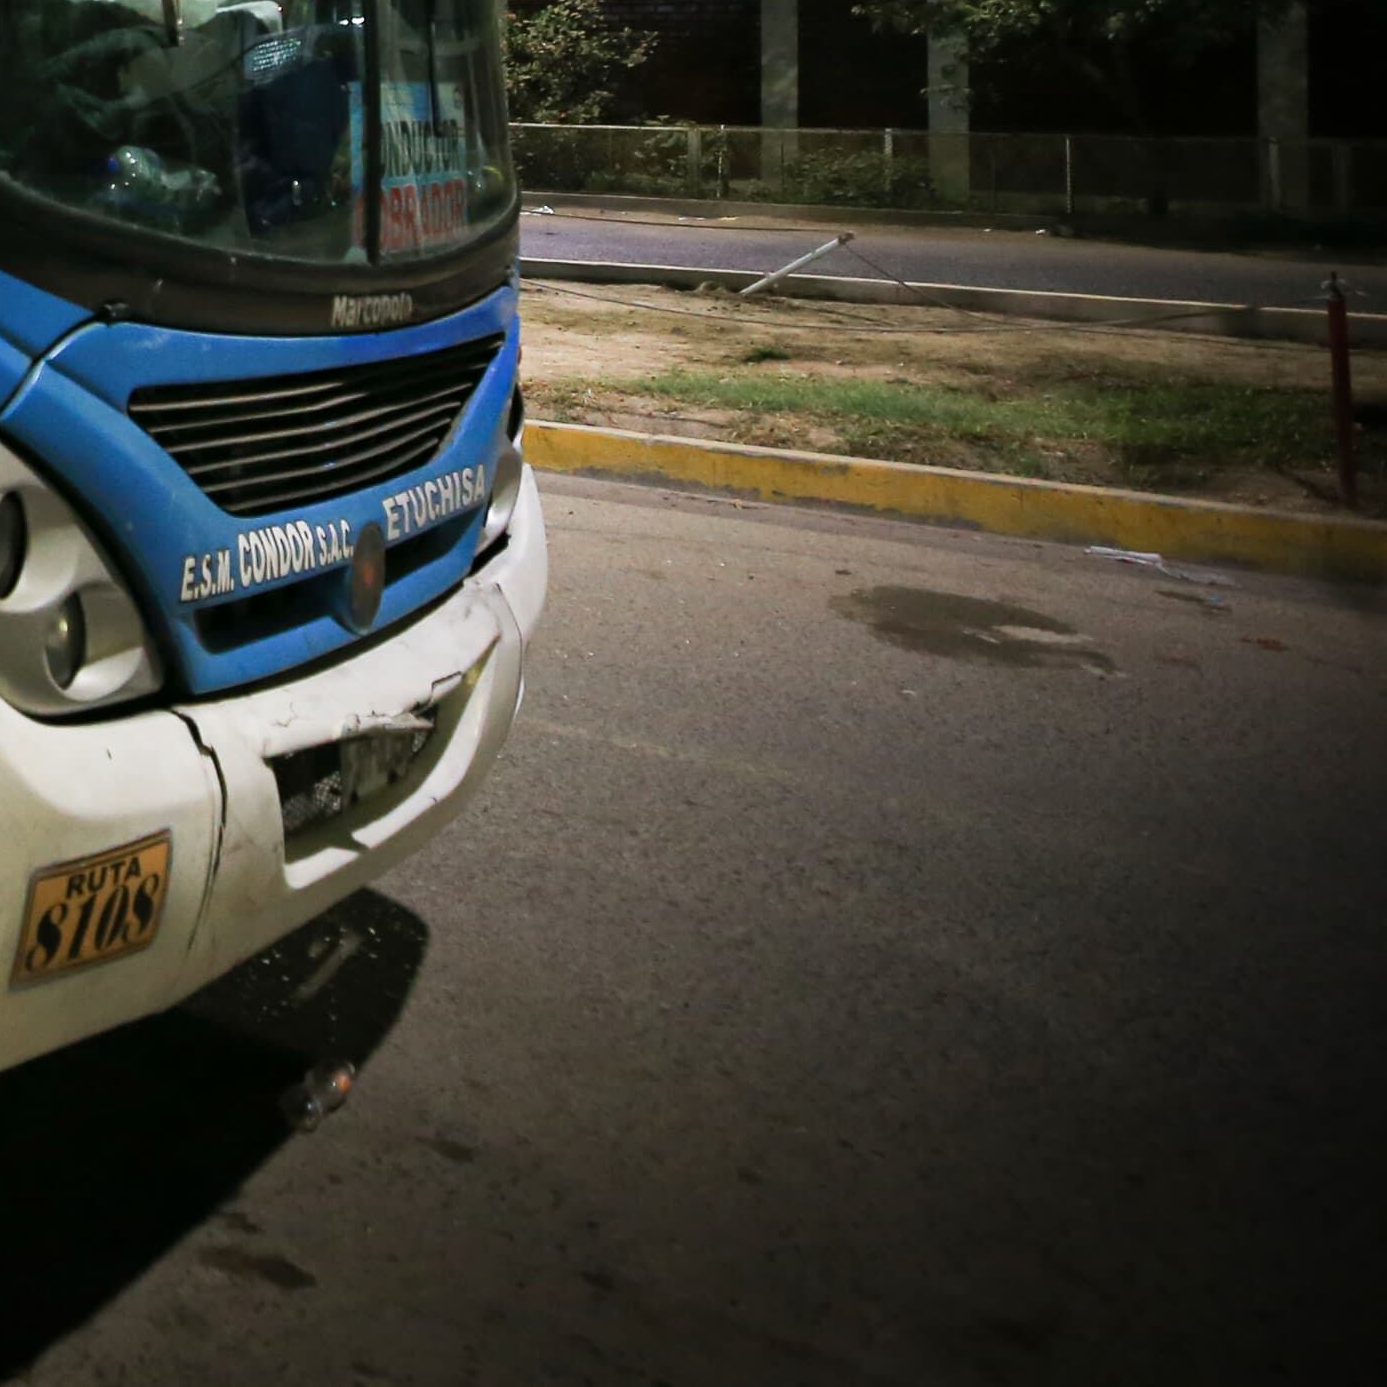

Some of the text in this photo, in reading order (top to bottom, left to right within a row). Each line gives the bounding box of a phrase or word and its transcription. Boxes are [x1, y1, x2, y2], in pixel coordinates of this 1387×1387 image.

[331, 292, 413, 327] Marcopolo
[382, 464, 486, 541] ETUCHISA
[180, 518, 354, 602] E.S.M. CONDOR S.A.C.
[66, 856, 141, 899] RUTA
[24, 873, 159, 972] 8108
